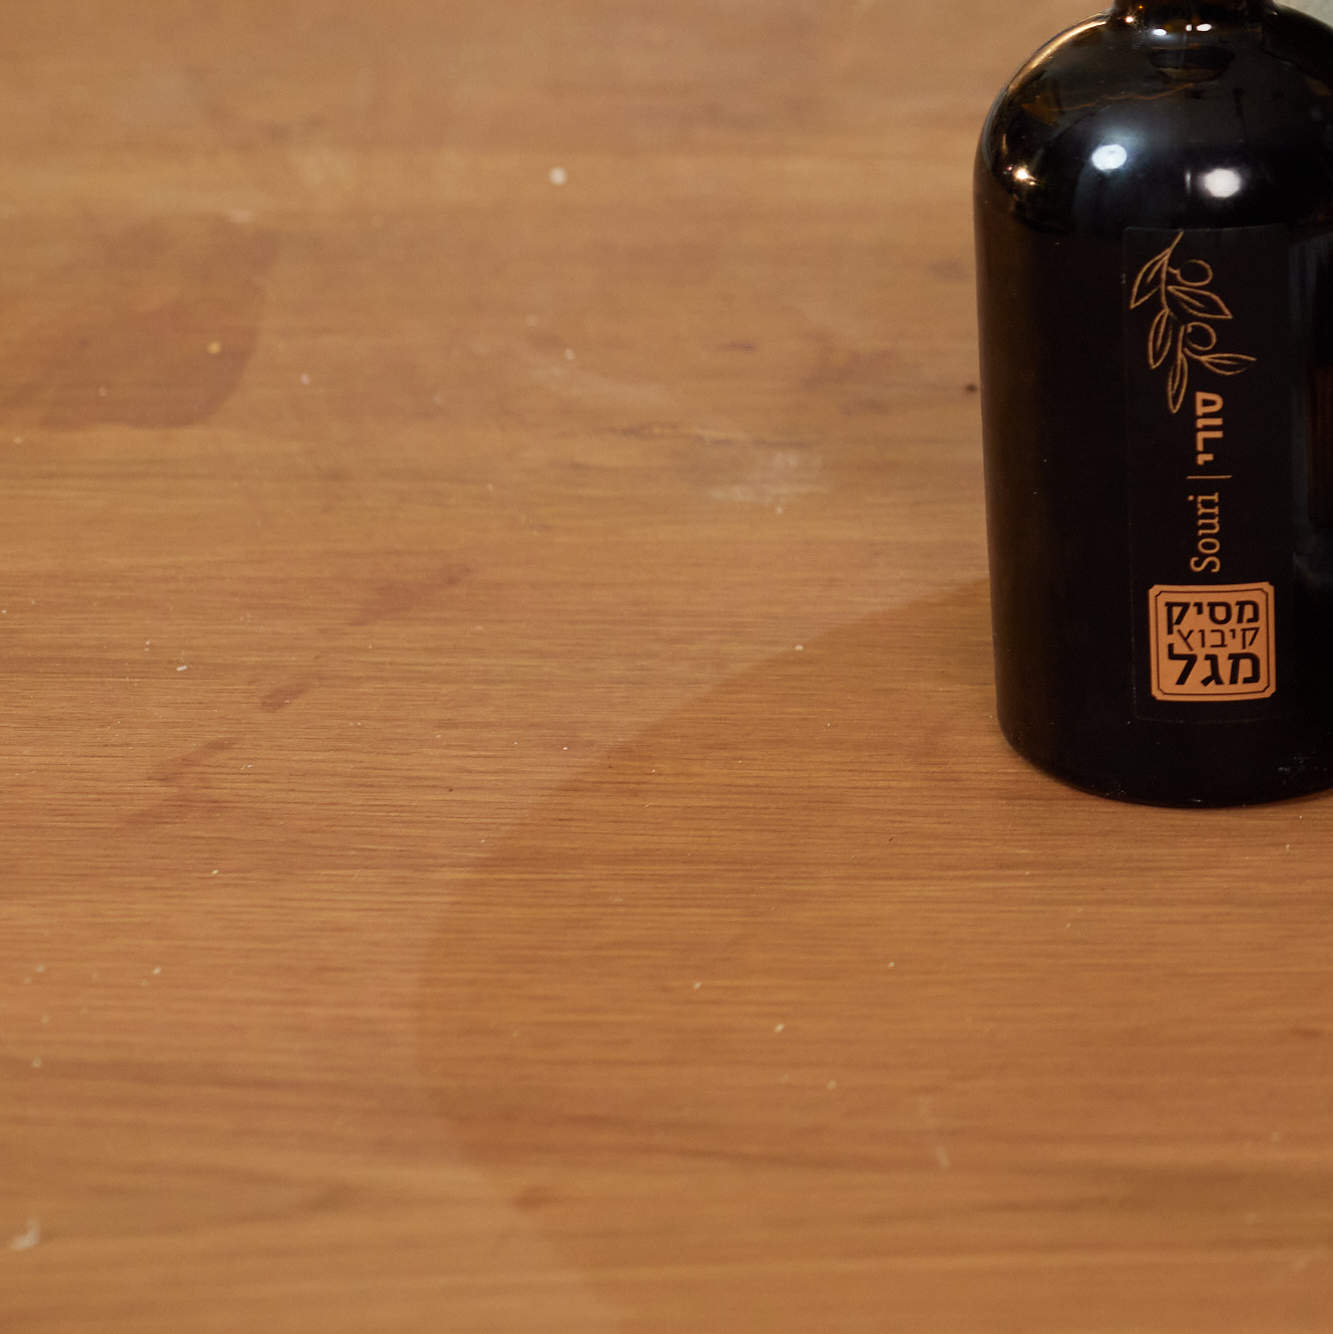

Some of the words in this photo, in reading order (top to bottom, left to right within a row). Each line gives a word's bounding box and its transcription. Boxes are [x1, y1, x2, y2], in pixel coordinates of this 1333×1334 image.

[1195, 391, 1224, 465] סורי
[1187, 492, 1221, 573] Souri
[1164, 599, 1260, 635] מסיק
[1177, 627, 1260, 652] קיבוץ
[1167, 642, 1261, 687] מגל
